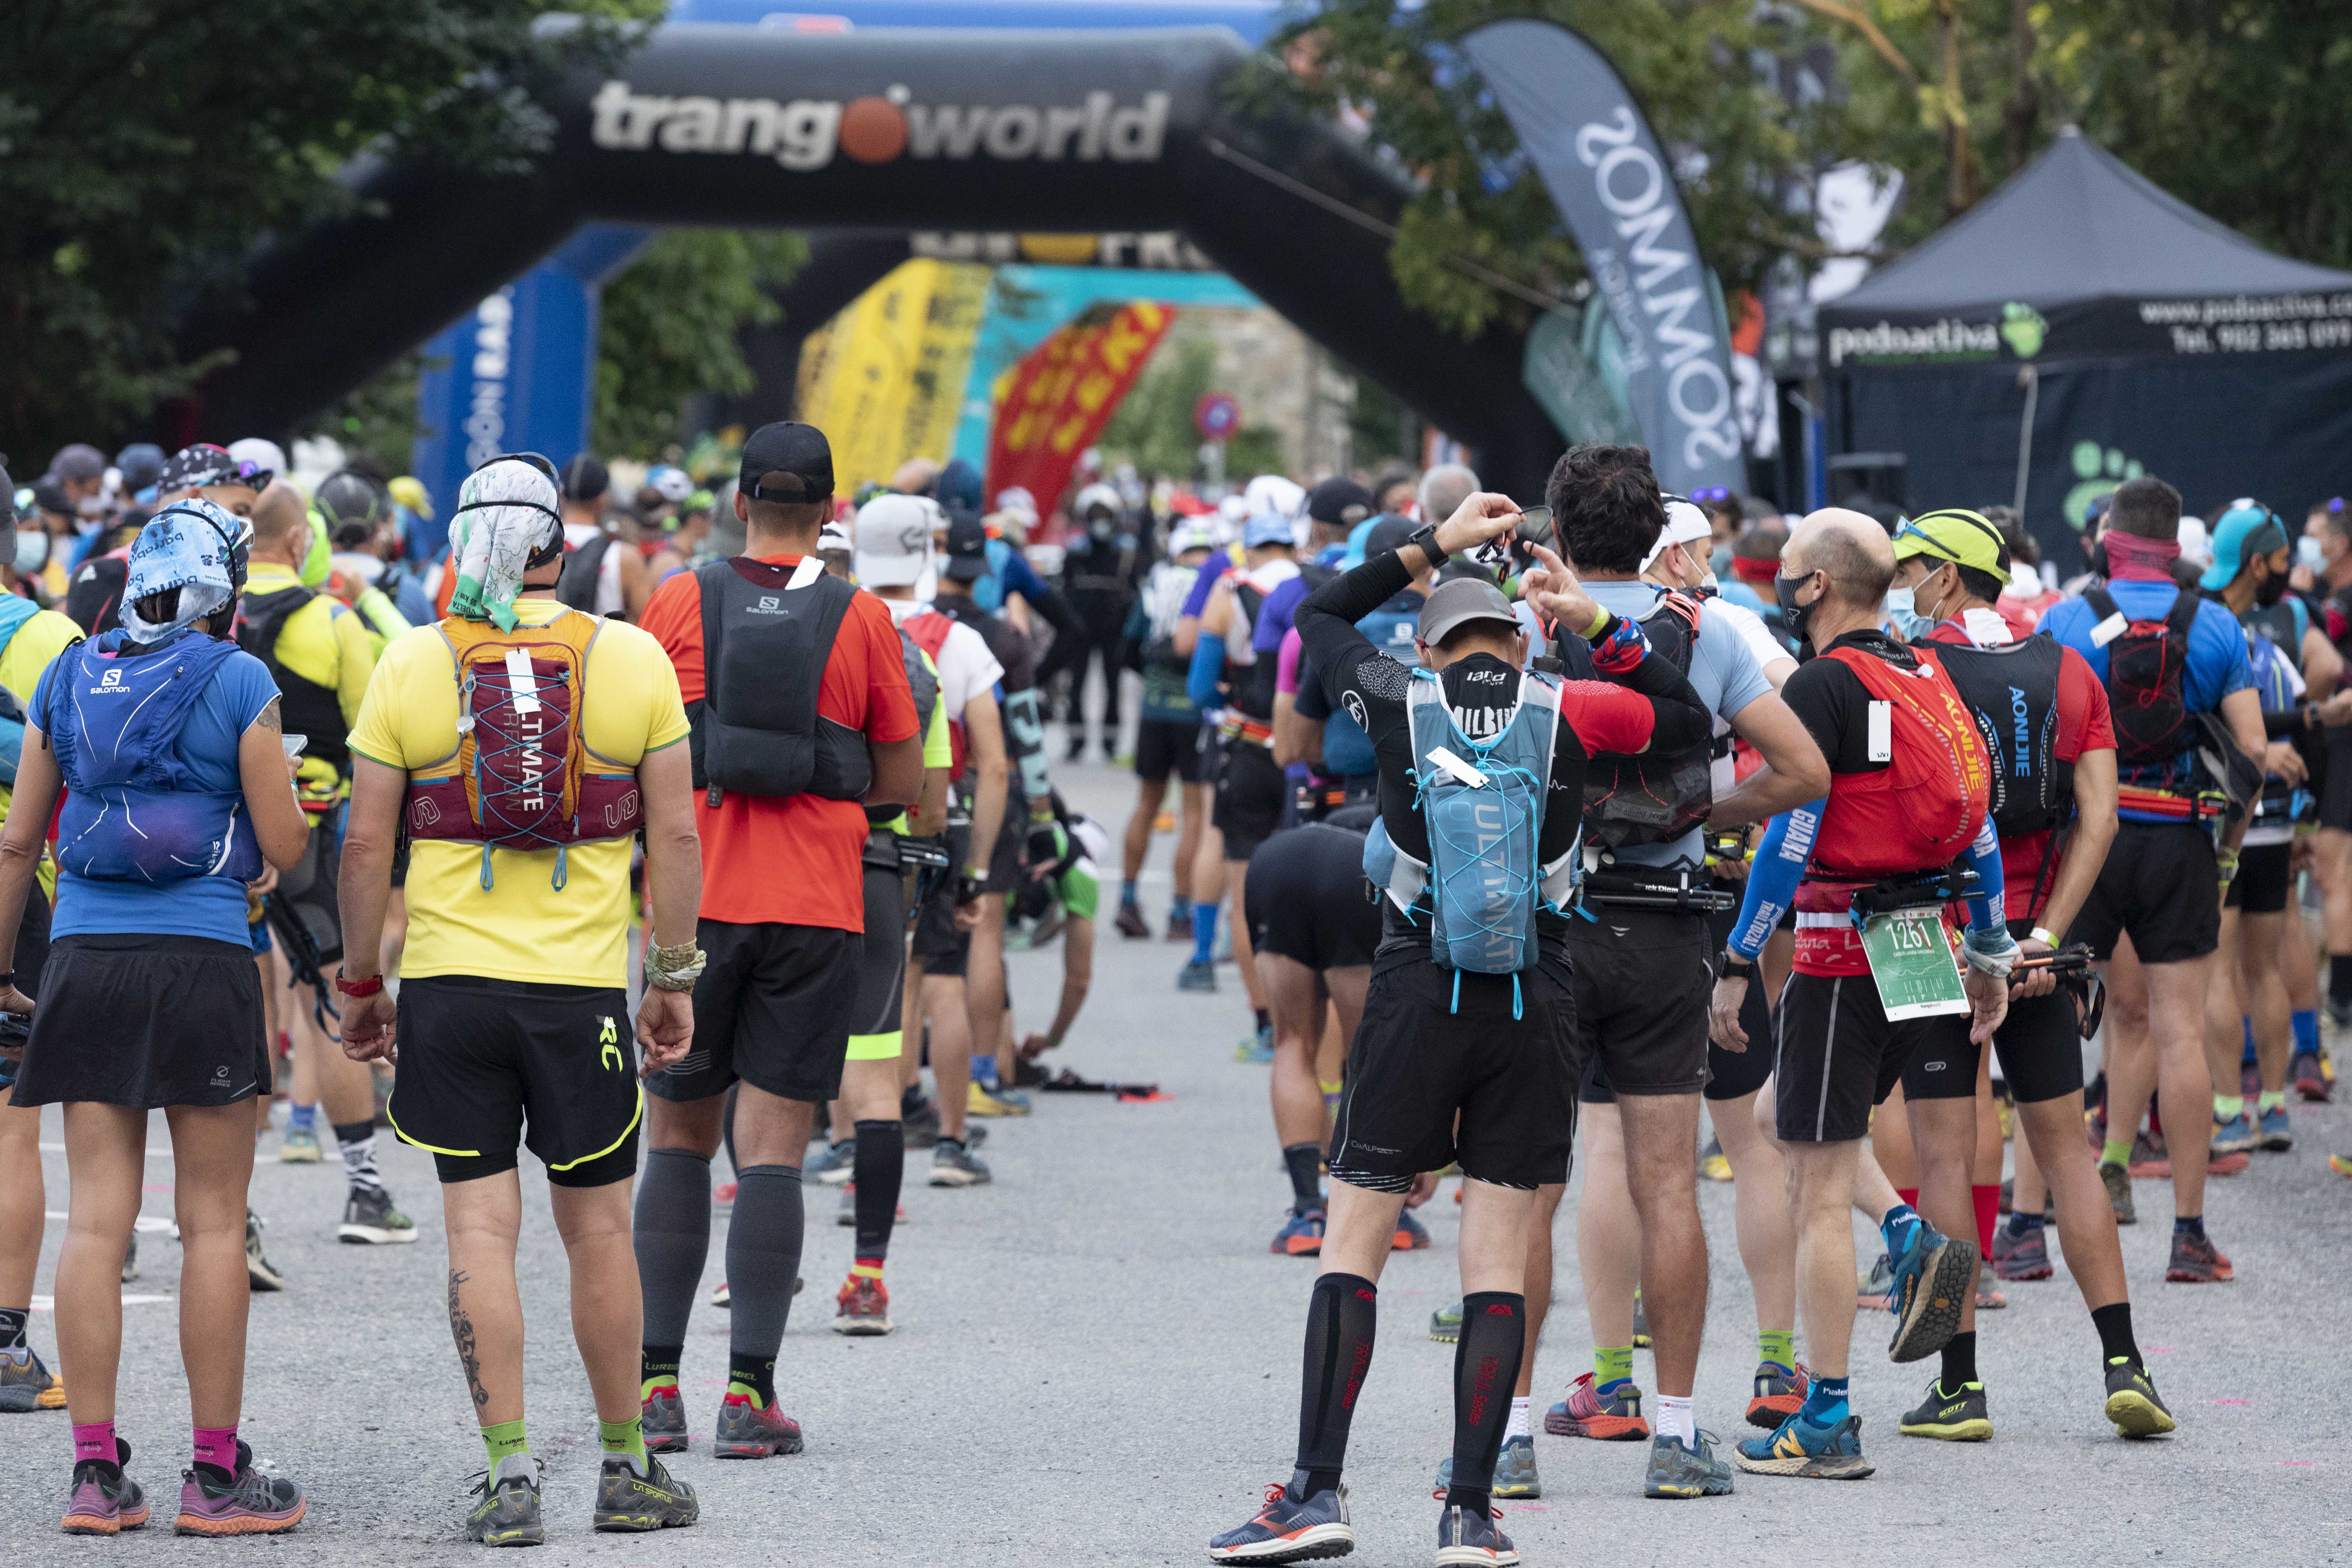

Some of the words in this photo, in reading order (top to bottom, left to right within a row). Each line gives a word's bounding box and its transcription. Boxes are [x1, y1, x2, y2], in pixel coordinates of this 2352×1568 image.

[1829, 319, 1997, 367] podoactiva
[453, 600, 476, 615] VUELTA
[460, 593, 469, 602] km
[1939, 692, 1980, 790] AONIJIE
[2009, 685, 2030, 777] AONIJIE
[521, 687, 544, 811] TIMATE
[1778, 808, 1817, 863] GUARA
[1885, 921, 1932, 950] 1261
[645, 1362, 679, 1370] LURBE
[731, 1370, 757, 1381] RBEL
[1938, 1401, 1967, 1419] SCOTT
[633, 1483, 644, 1493] LA
[645, 1488, 672, 1503] SPORTIVA
